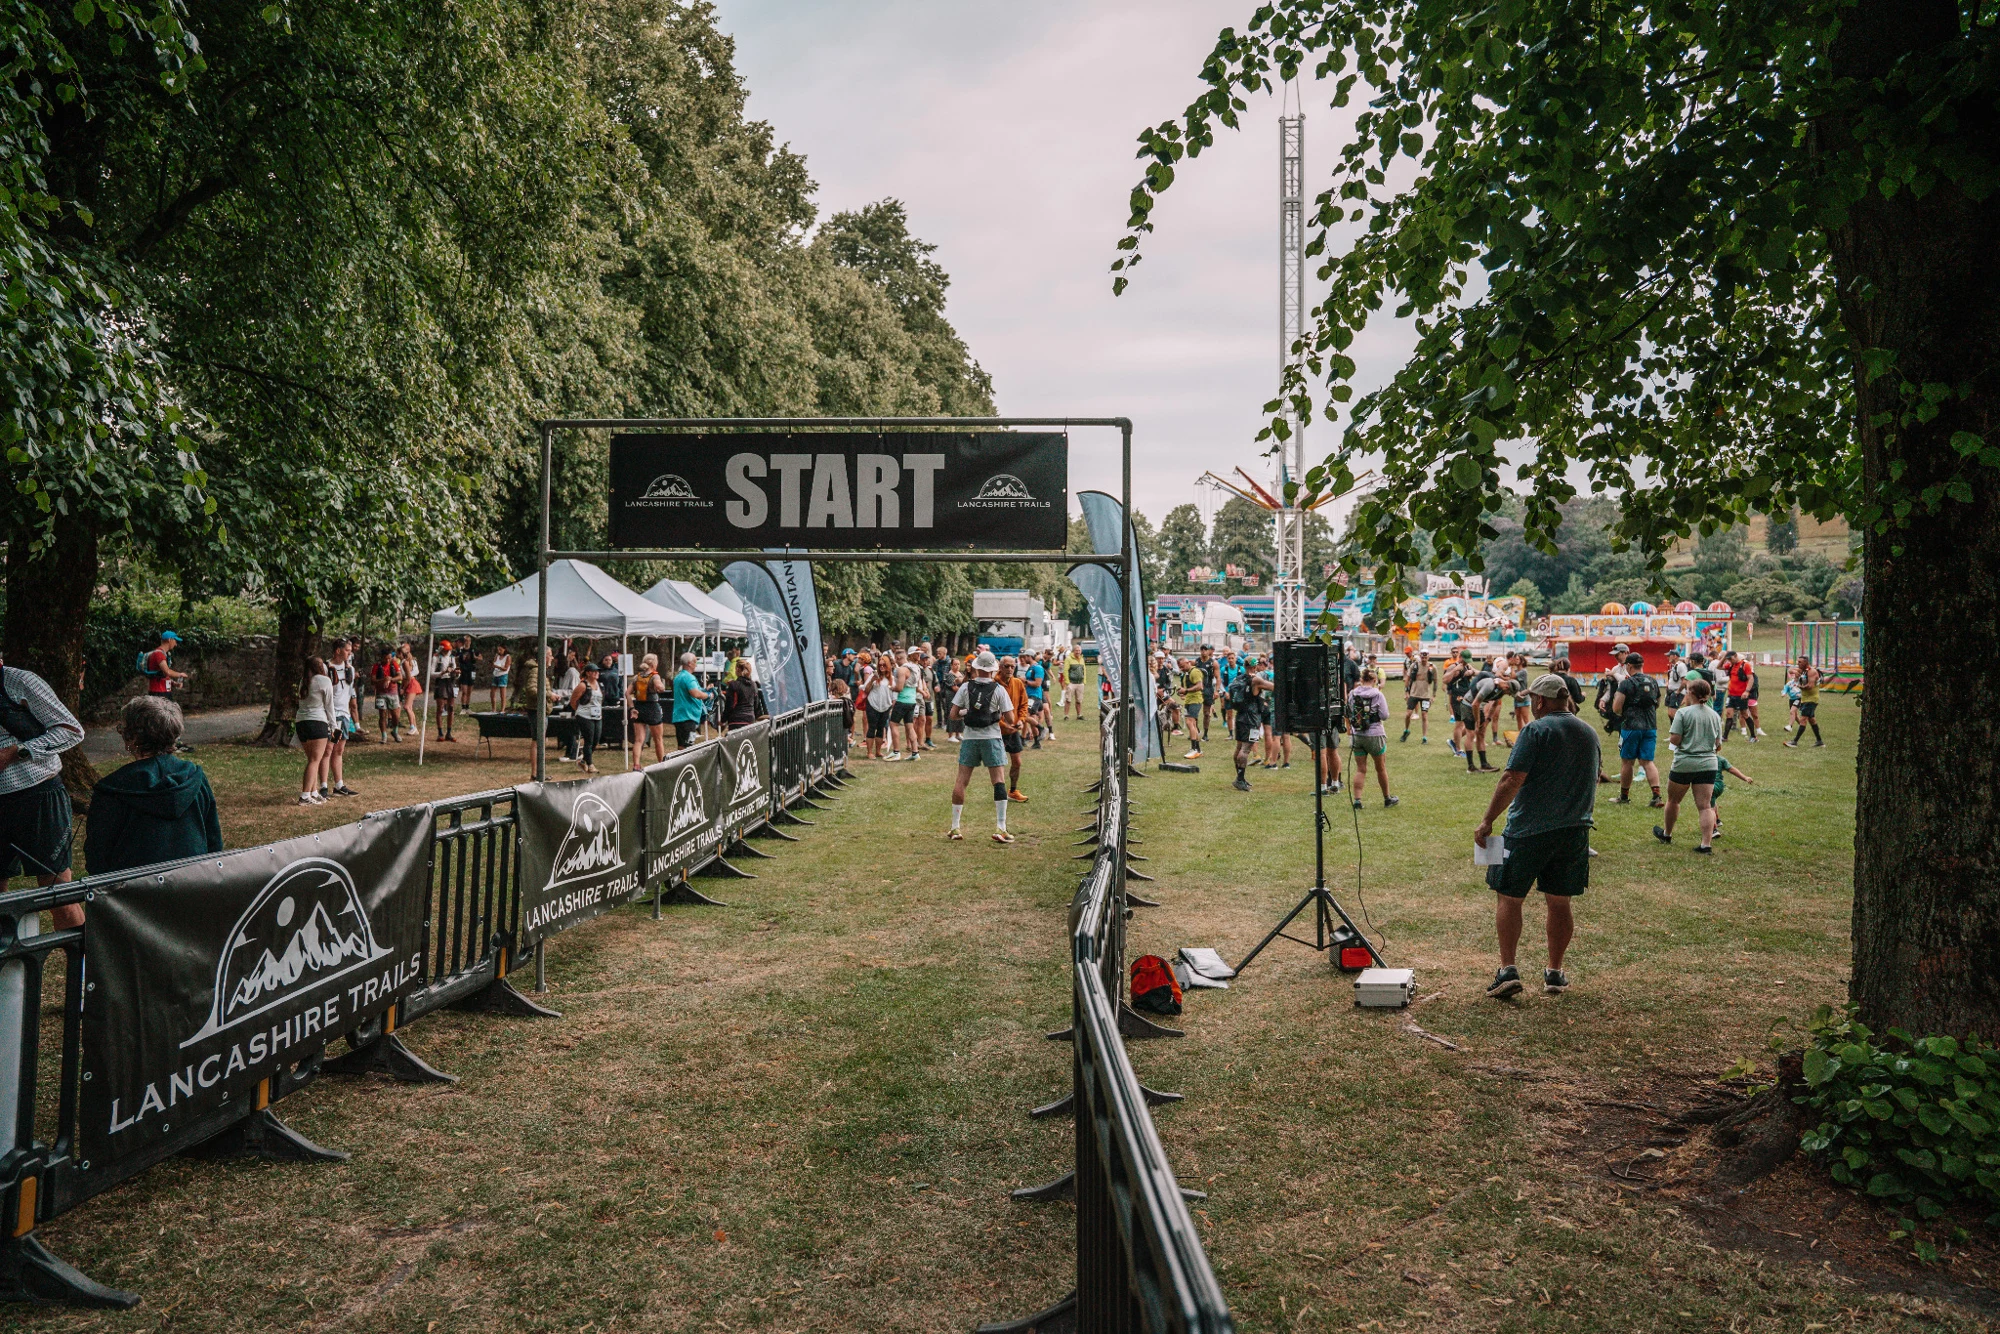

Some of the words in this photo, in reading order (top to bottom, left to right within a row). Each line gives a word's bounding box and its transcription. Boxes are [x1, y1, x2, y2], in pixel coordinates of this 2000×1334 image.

[725, 452, 945, 529] START
[647, 842, 695, 880] LANCASHIRE
[695, 825, 724, 849] TRAILS
[526, 885, 603, 931] LANCASHIRE
[606, 871, 639, 898] TRAILS
[109, 996, 340, 1135] LANCASHIRE
[348, 951, 422, 1014] TRAILS
